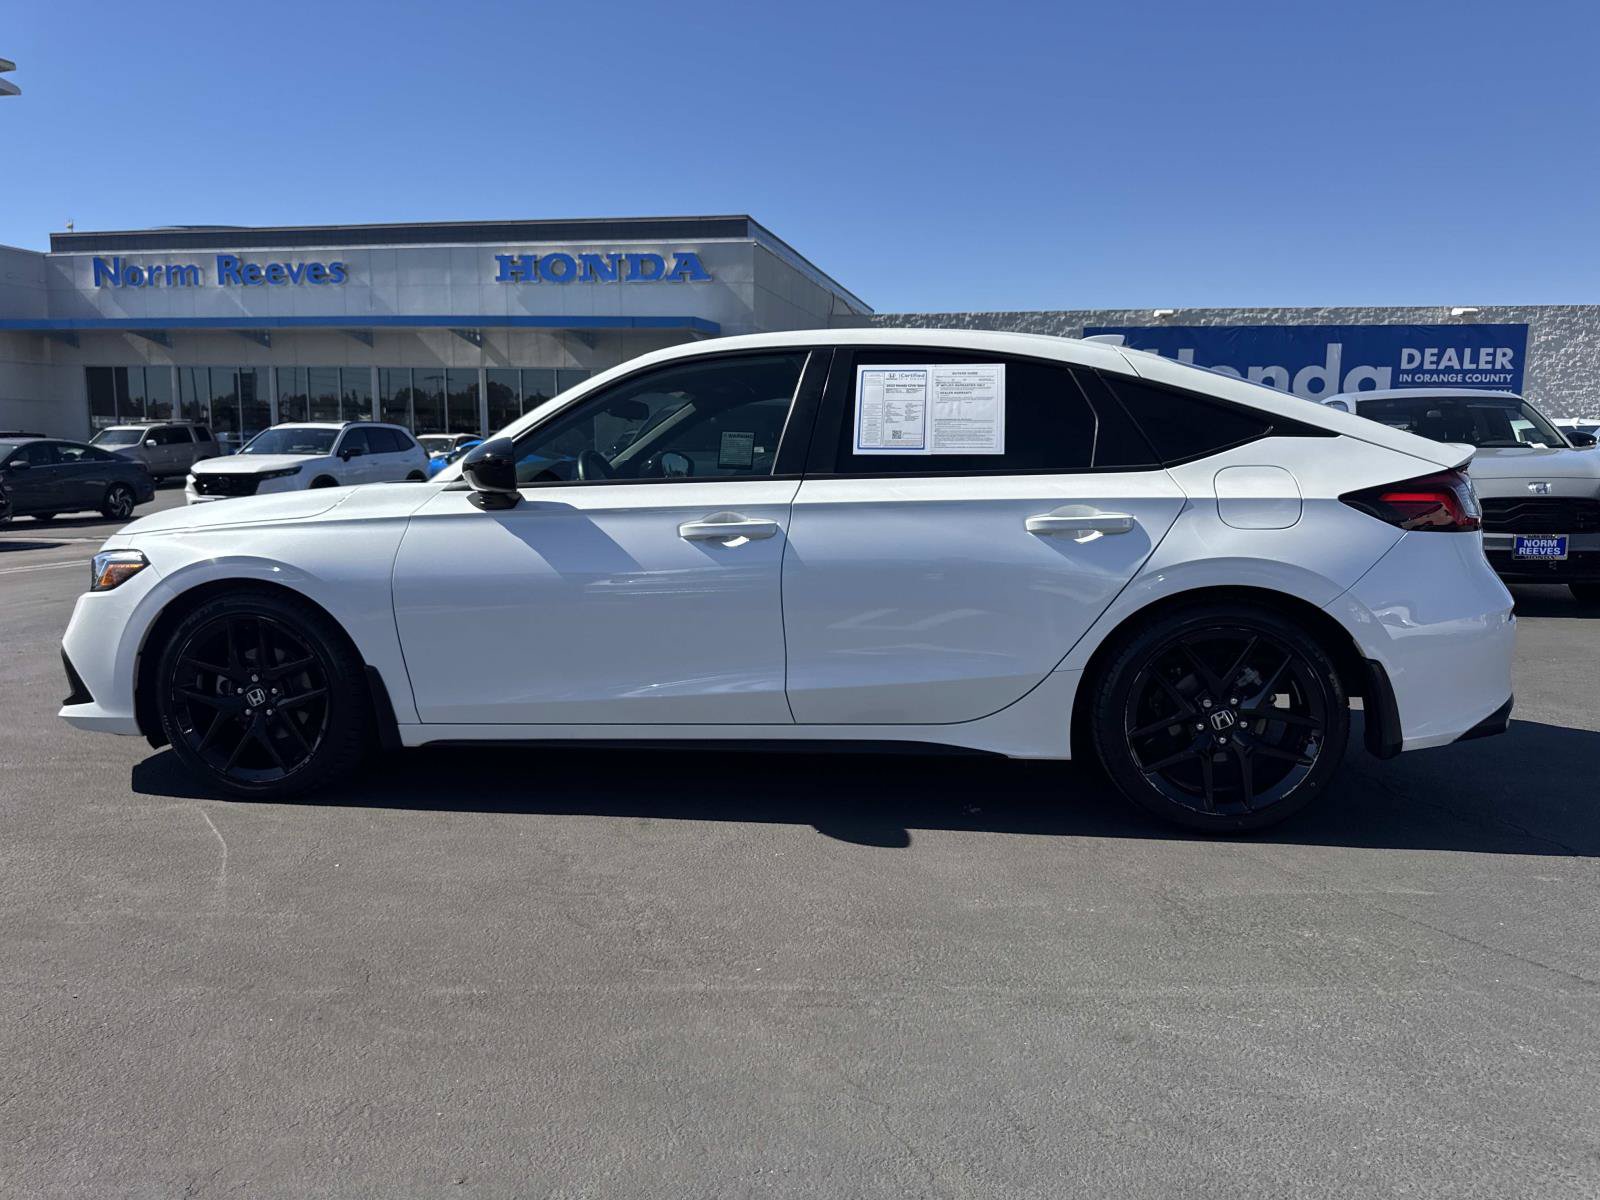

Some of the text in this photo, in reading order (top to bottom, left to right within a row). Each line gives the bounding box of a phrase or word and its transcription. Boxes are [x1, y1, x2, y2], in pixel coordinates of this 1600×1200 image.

[92, 254, 346, 288] Norm Reeves
[495, 252, 712, 283] HONDA
[1400, 347, 1514, 370] DEALER
[1399, 373, 1513, 383] IN ORANGE COUNTY
[1519, 547, 1561, 555] REEVES
[1523, 539, 1557, 547] NORM
